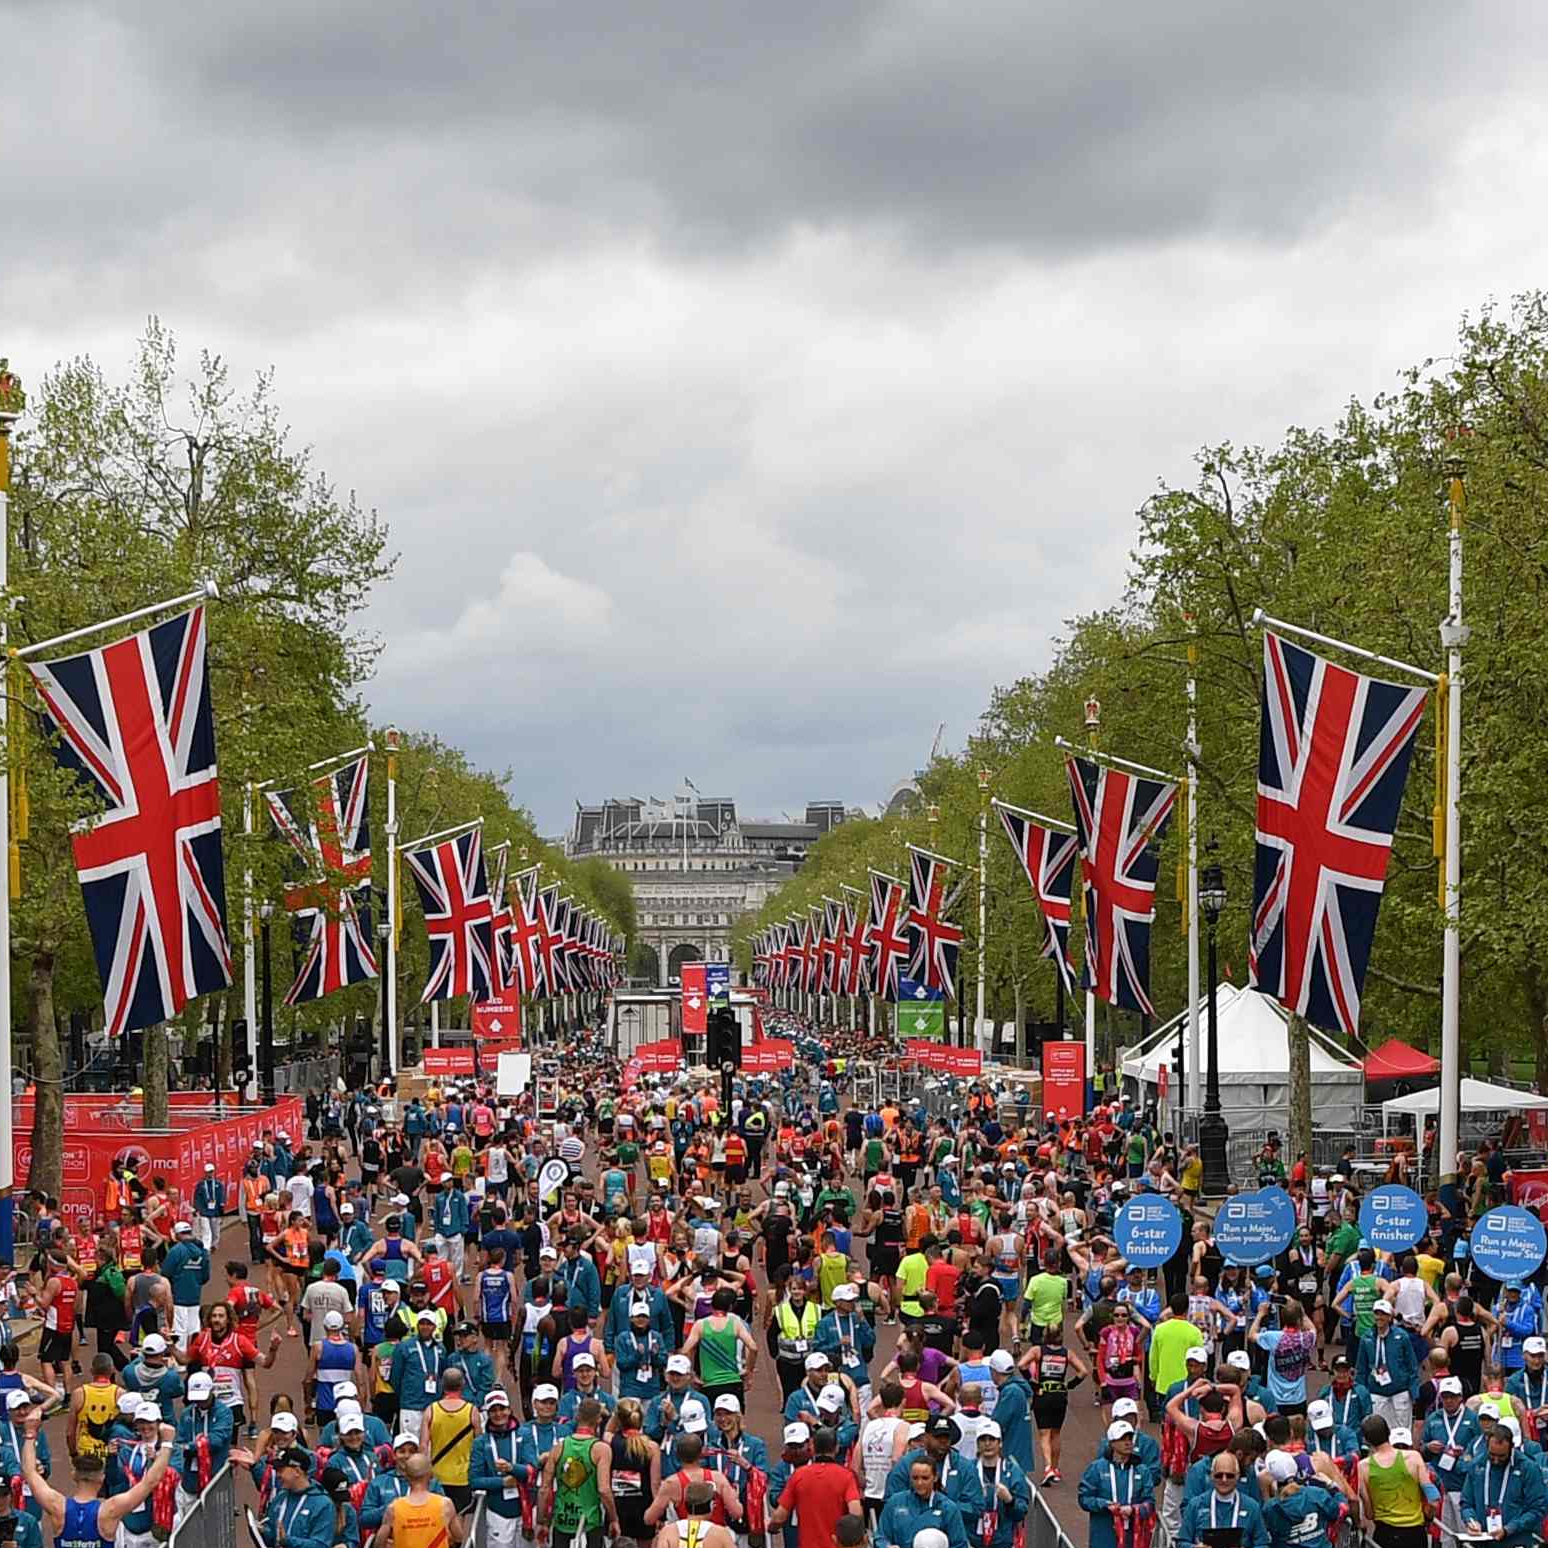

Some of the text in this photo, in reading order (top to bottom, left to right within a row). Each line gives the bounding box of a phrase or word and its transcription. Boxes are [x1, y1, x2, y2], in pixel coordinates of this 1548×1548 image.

[1375, 1214, 1412, 1227] 6-star
[1131, 1226, 1166, 1240] 6-star
[1223, 1223, 1238, 1233] Run
[1371, 1228, 1416, 1242] finisher
[1216, 1231, 1281, 1246] Claim your Star
[1480, 1234, 1495, 1246] Run
[1126, 1241, 1169, 1256] finisher
[1473, 1244, 1500, 1257] Claim
[1501, 1248, 1521, 1260] your
